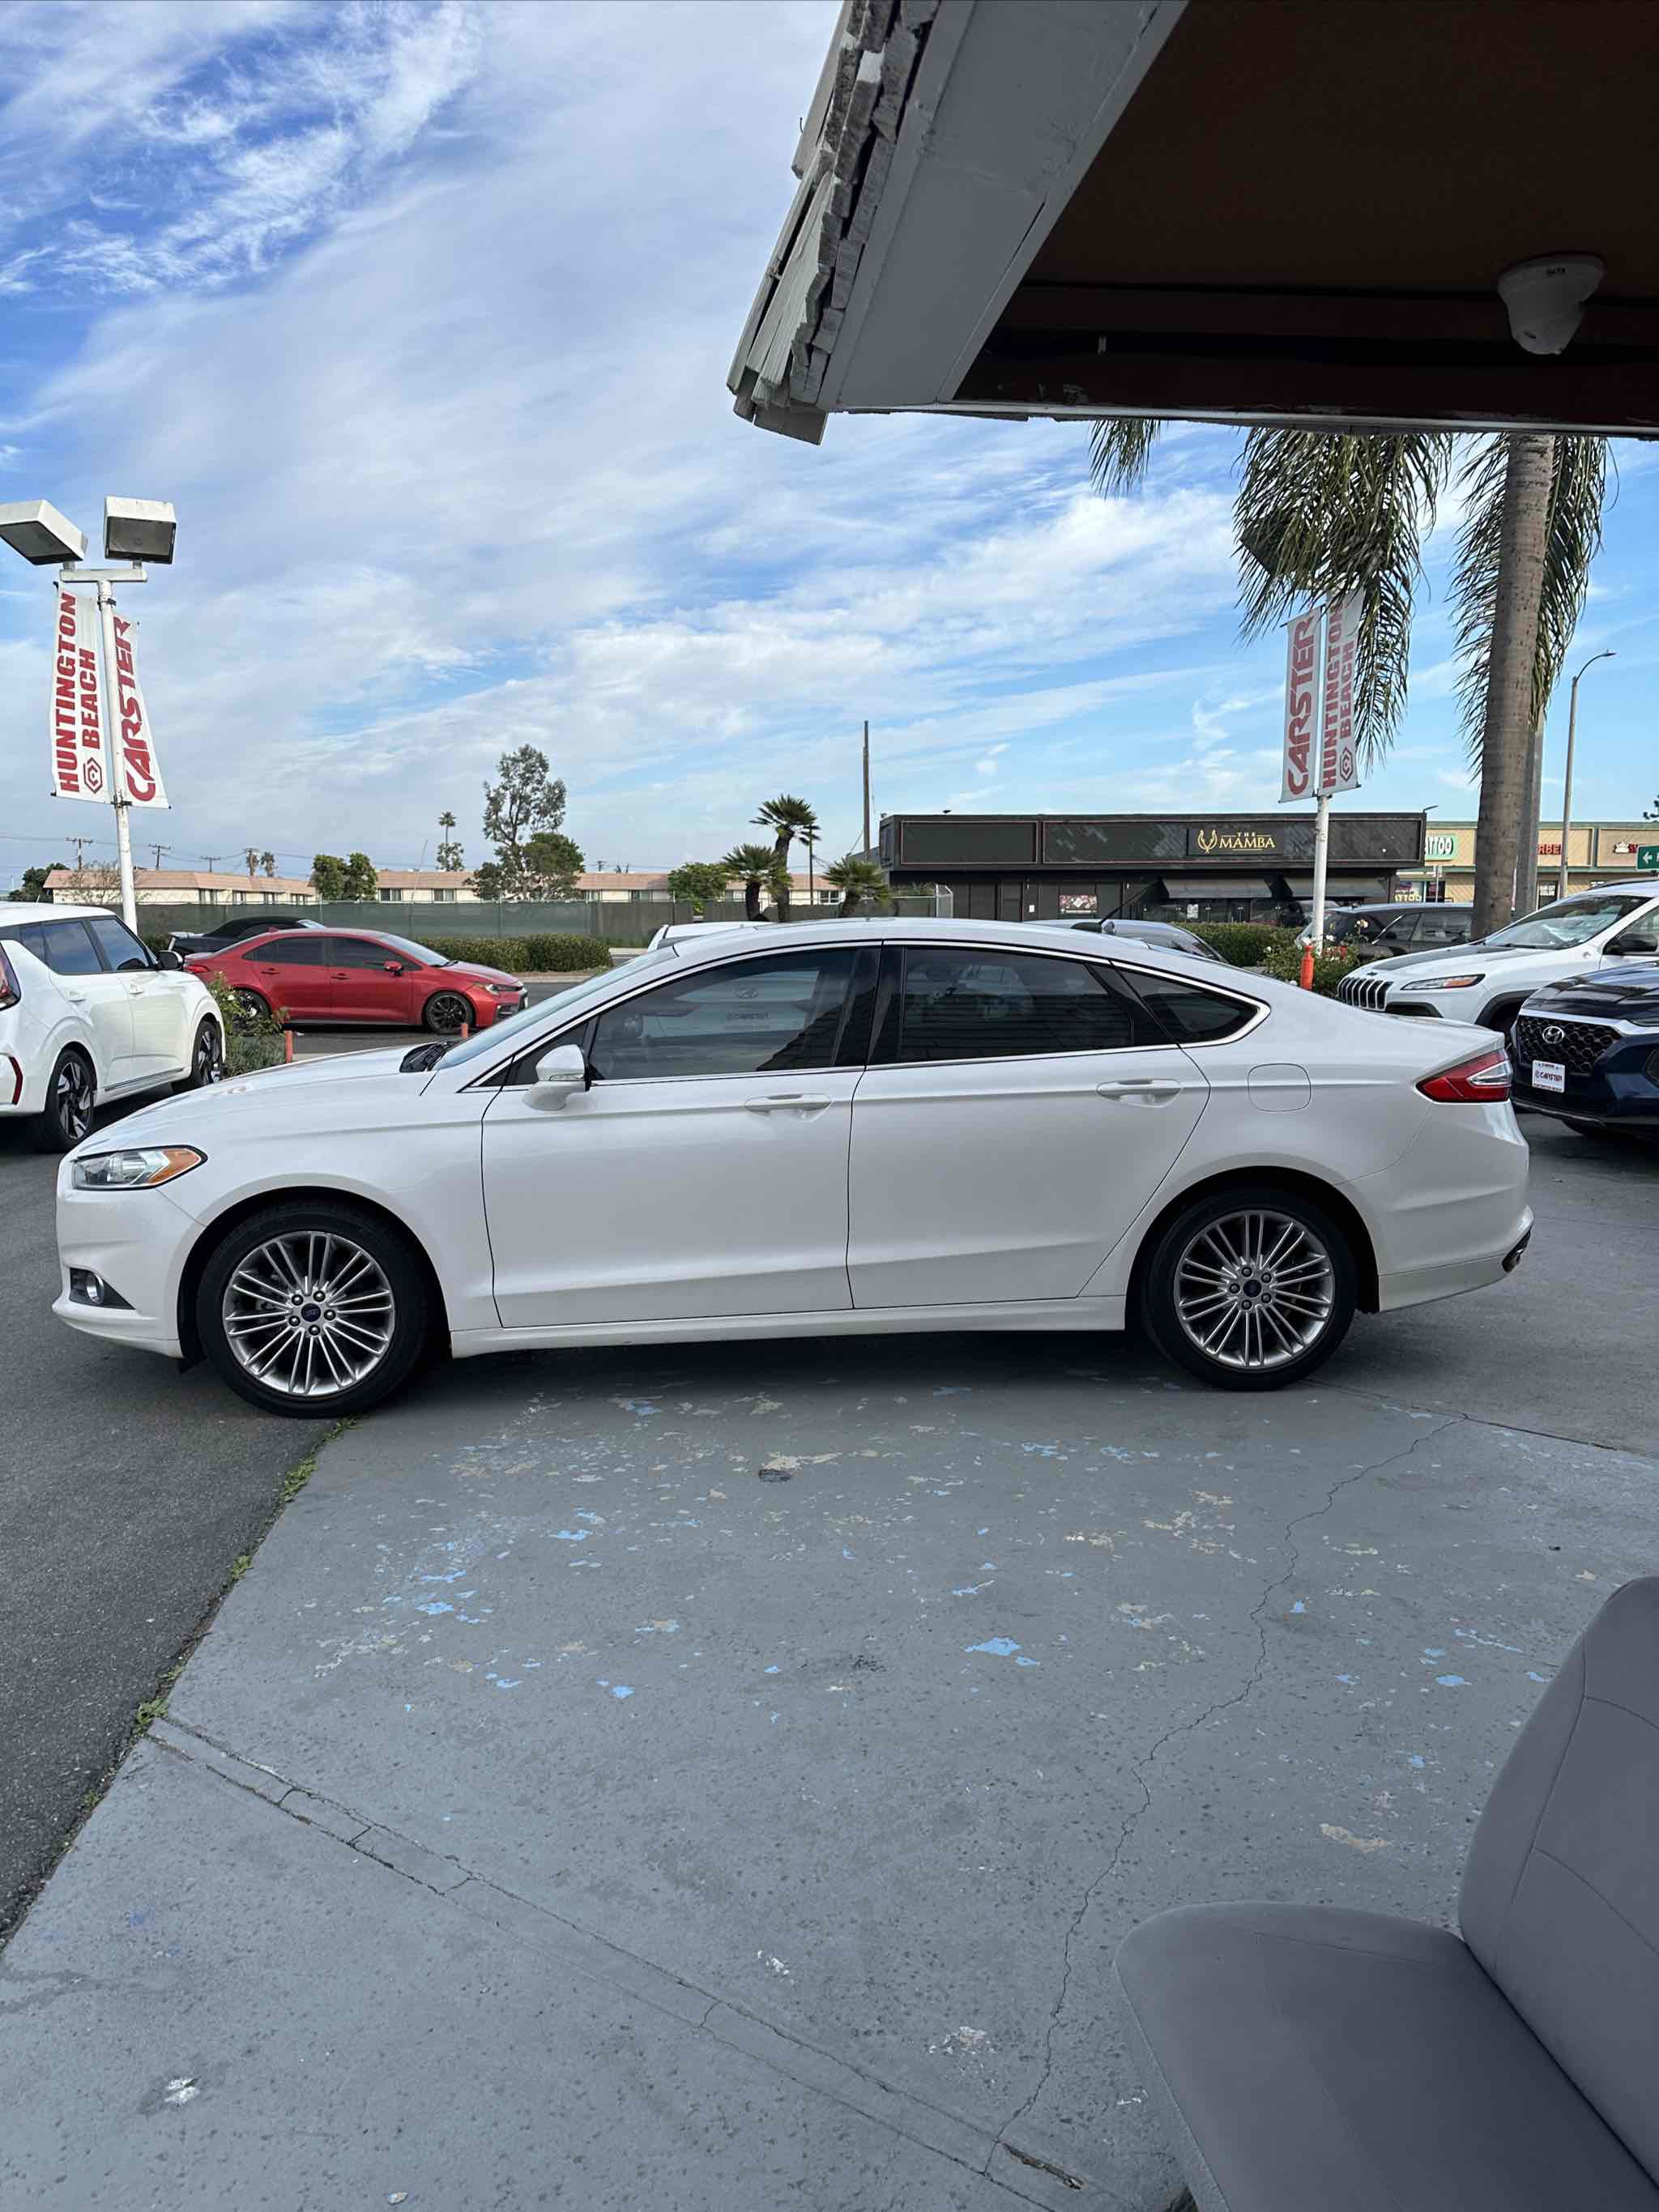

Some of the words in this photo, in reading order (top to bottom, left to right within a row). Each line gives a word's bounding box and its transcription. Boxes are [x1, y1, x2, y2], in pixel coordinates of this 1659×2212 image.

[56, 592, 79, 793] HUNTINGTON
[79, 647, 101, 749] BEACH
[113, 615, 156, 801] CARSTER
[1288, 613, 1314, 795] CARSTER
[1340, 641, 1355, 739] BEACH
[1219, 837, 1276, 848] MAMBA
